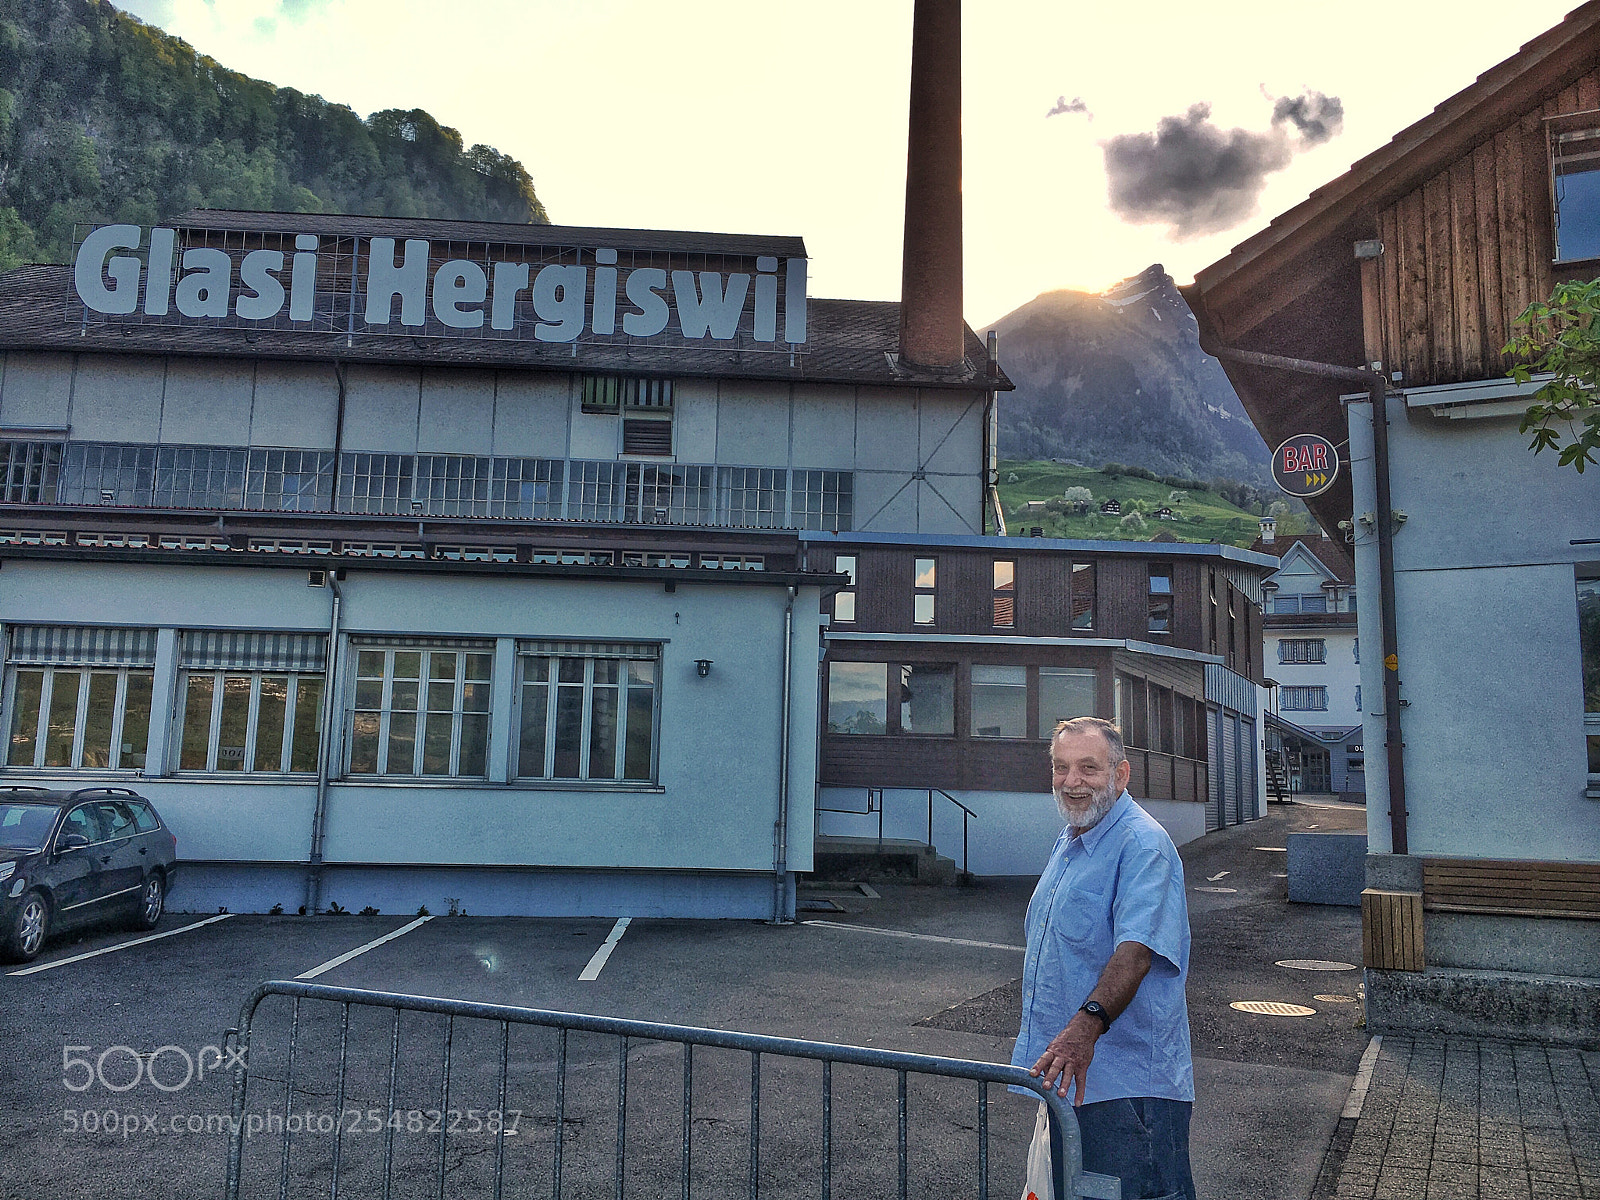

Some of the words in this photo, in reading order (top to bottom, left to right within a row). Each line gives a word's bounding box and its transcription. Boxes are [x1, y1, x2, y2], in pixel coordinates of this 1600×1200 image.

[75, 225, 318, 321] Glasi
[365, 238, 808, 342] Hergiswil
[1283, 444, 1328, 473] BAR
